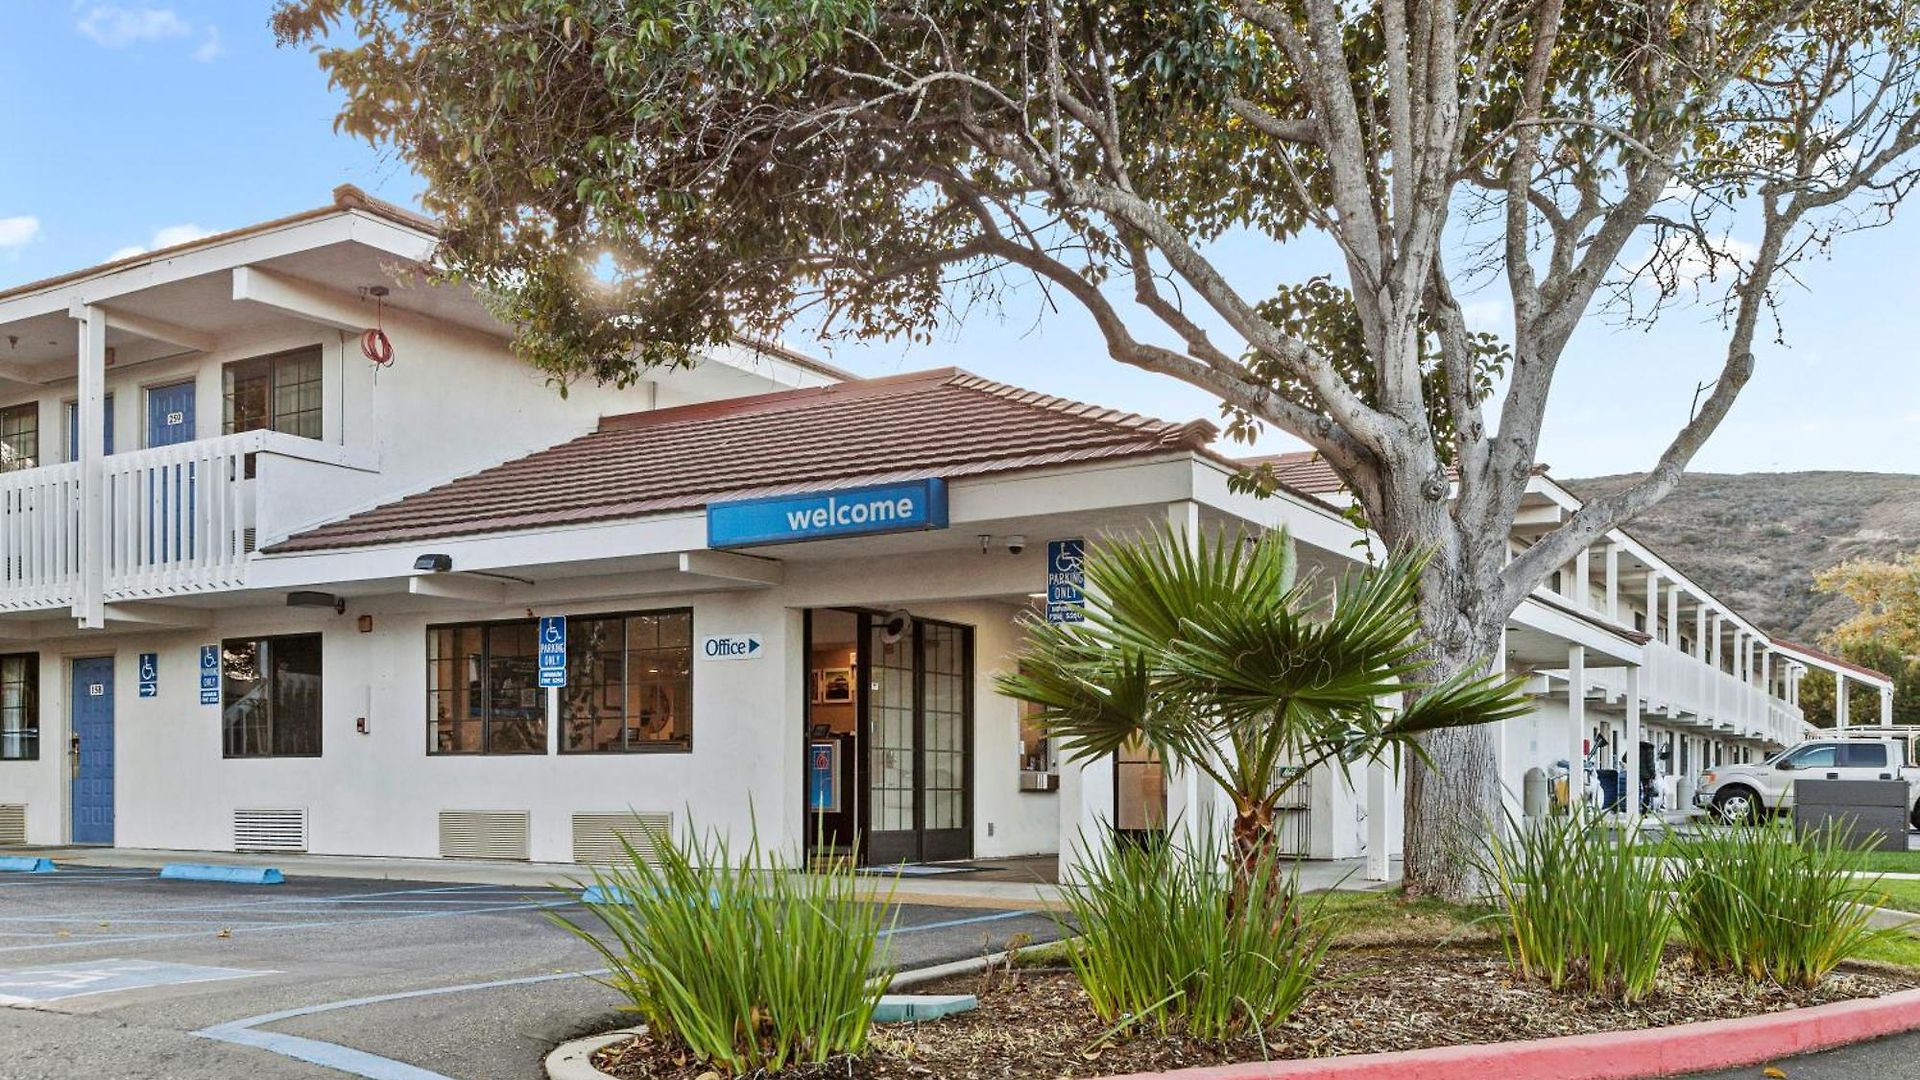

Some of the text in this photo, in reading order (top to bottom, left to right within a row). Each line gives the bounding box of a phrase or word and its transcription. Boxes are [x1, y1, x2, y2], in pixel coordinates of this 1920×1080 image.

[787, 497, 913, 531] welcome
[1049, 572, 1084, 585] PARKING
[1055, 587, 1077, 600] ONLY
[541, 643, 565, 654] PARKING
[705, 638, 747, 657] Office
[545, 655, 560, 666] ONLY
